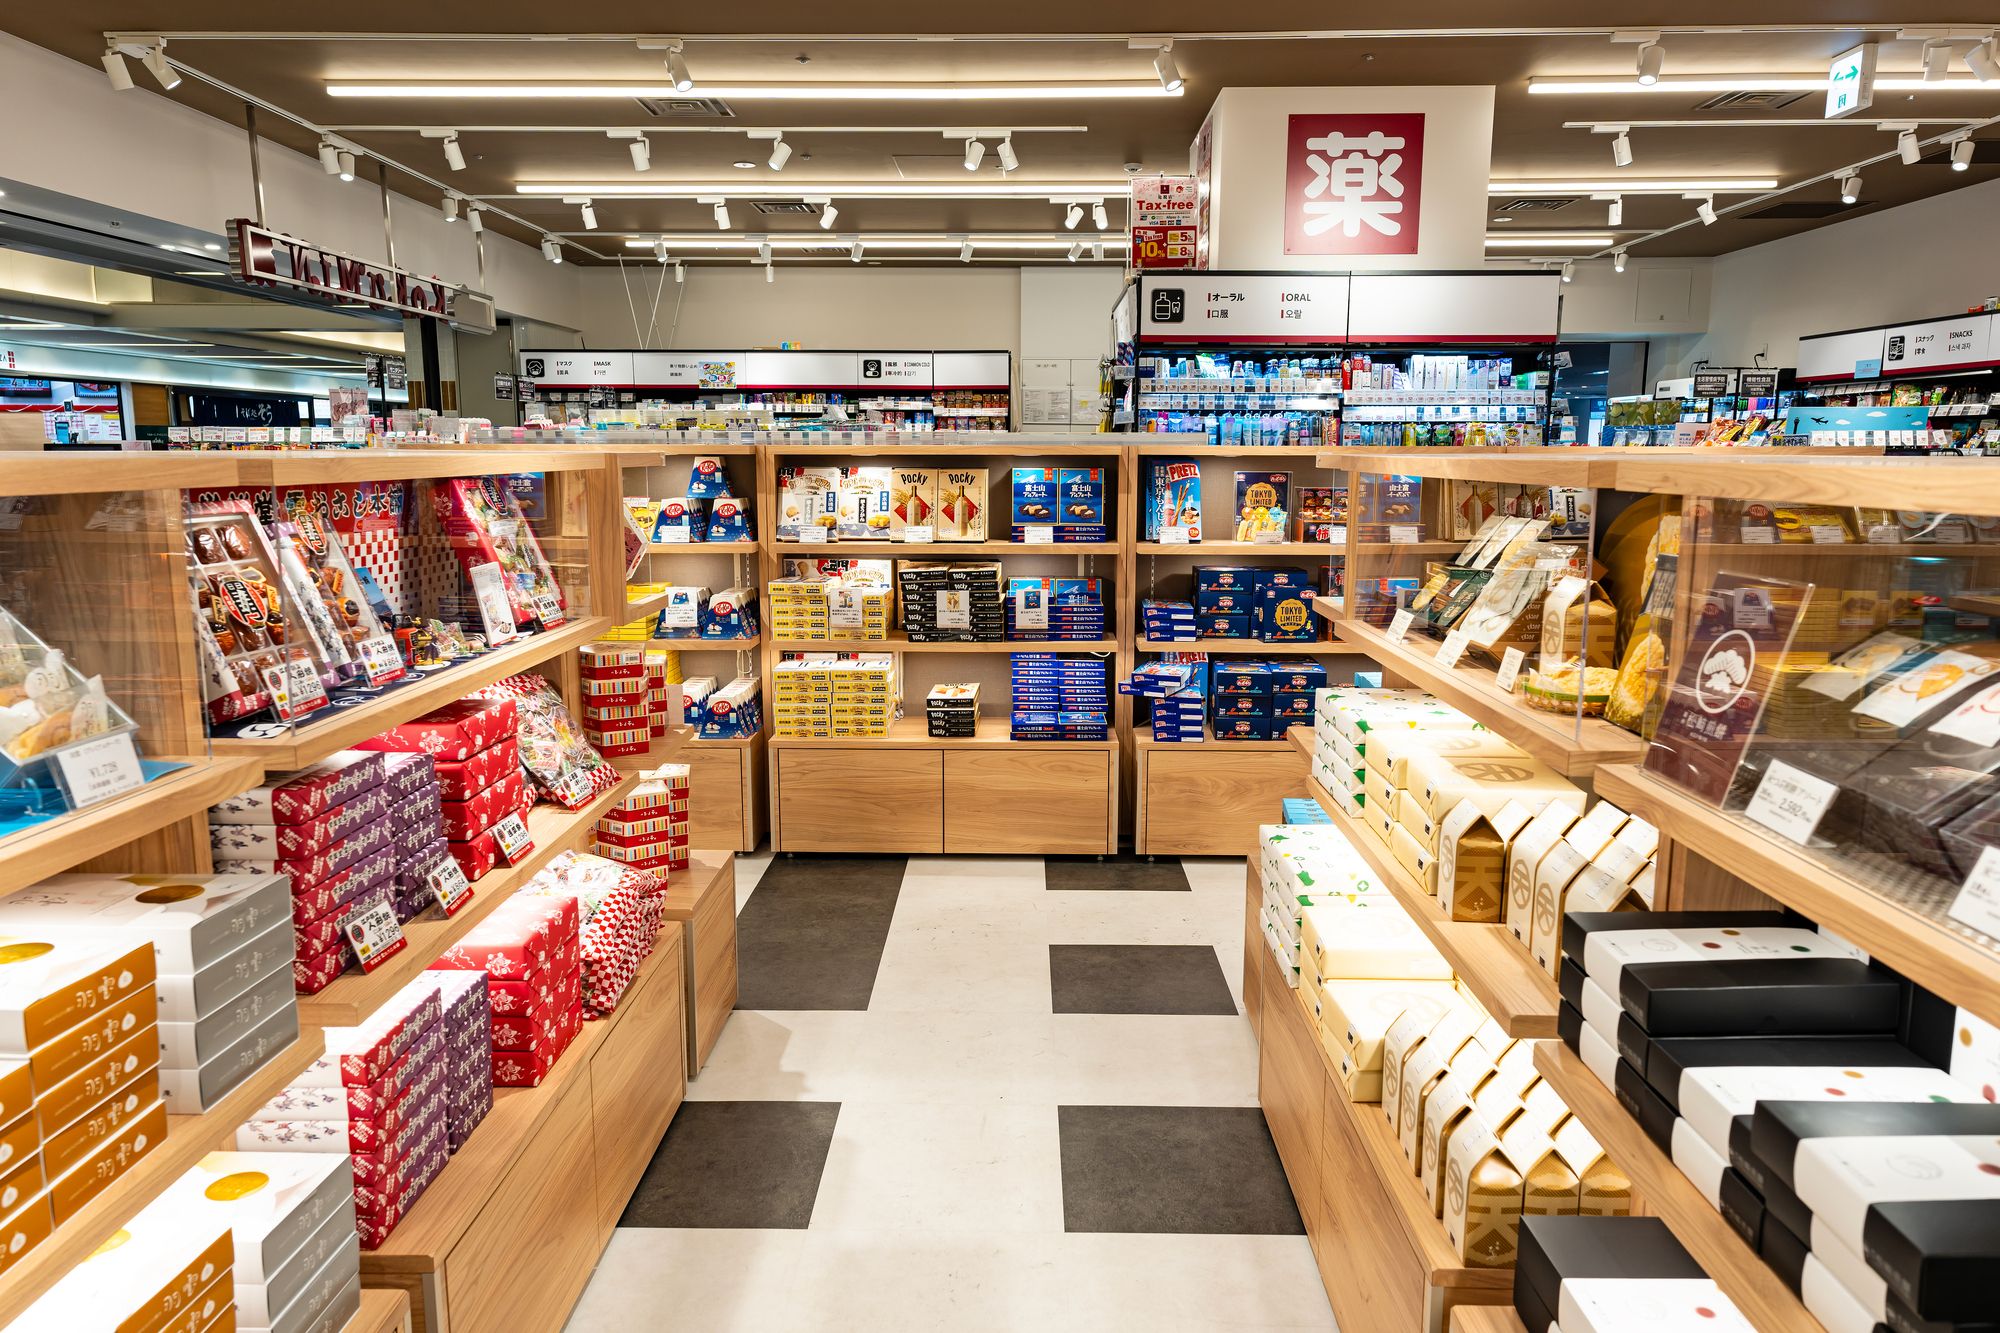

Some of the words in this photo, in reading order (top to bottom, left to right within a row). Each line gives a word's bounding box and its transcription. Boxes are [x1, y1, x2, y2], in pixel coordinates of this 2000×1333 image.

[1303, 130, 1406, 238] 薬
[1136, 200, 1194, 211] Tax-free
[1212, 292, 1245, 302] オーラル
[1286, 293, 1312, 302] ORAL
[1211, 309, 1229, 319] 口服
[1918, 334, 1935, 343] スナック
[1952, 330, 1973, 339] SNACKS
[1168, 464, 1198, 480] PRETZ
[901, 471, 929, 486] Pocky
[948, 471, 976, 486] Pocky
[1025, 484, 1046, 492] 富士山
[1071, 484, 1092, 492] 富士山
[1250, 489, 1273, 498] TOKYO
[1249, 498, 1272, 506] LIMITED
[1280, 607, 1303, 615] TOKYO
[1280, 615, 1303, 623] LIMITED
[376, 923, 400, 943] ¥1296
